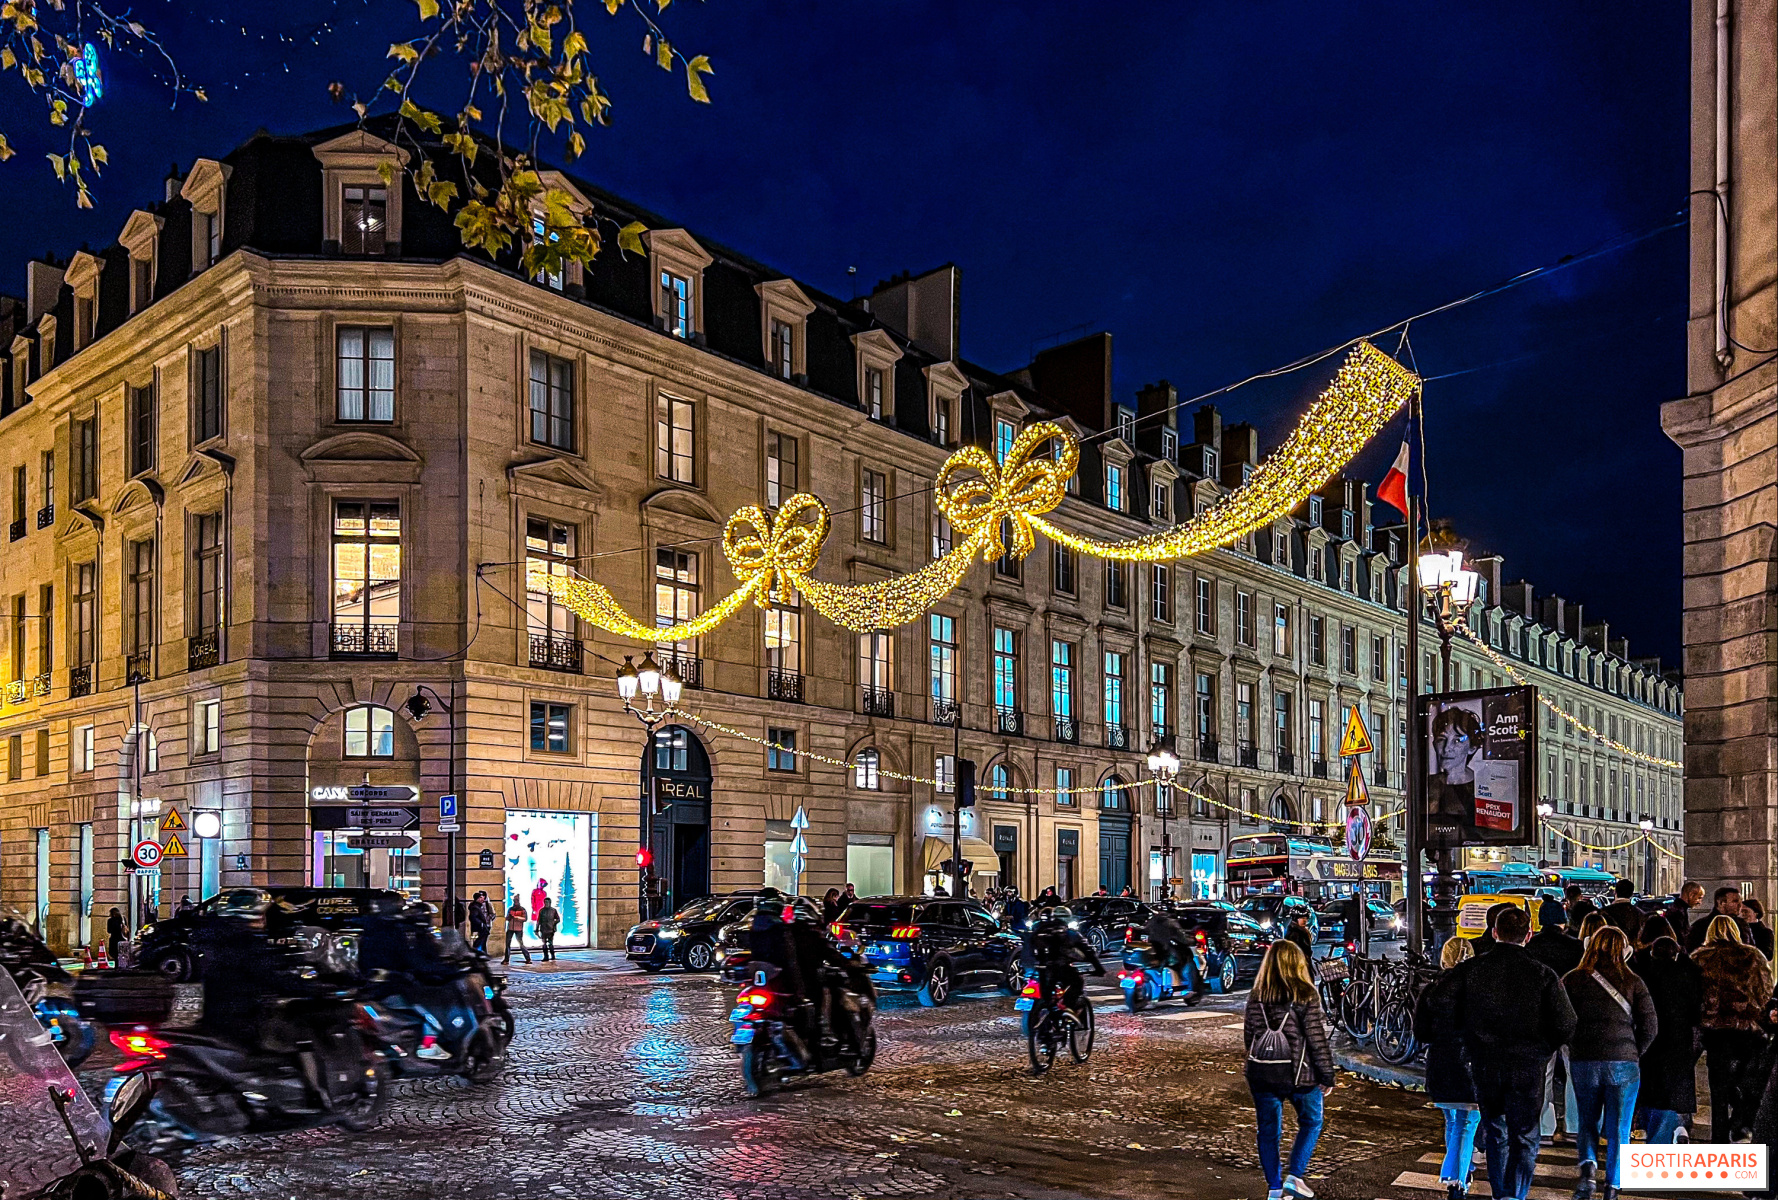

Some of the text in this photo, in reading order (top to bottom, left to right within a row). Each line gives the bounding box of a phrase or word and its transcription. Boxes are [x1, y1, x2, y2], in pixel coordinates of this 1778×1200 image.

[1495, 713, 1519, 724] Ann
[1488, 725, 1519, 736] Scott
[642, 781, 705, 798] LRÉAL
[444, 800, 452, 814] P
[1476, 807, 1511, 819] RENAUDOT
[1485, 803, 1501, 811] PRIX
[139, 848, 158, 860] 30
[1362, 864, 1378, 878] ARIS
